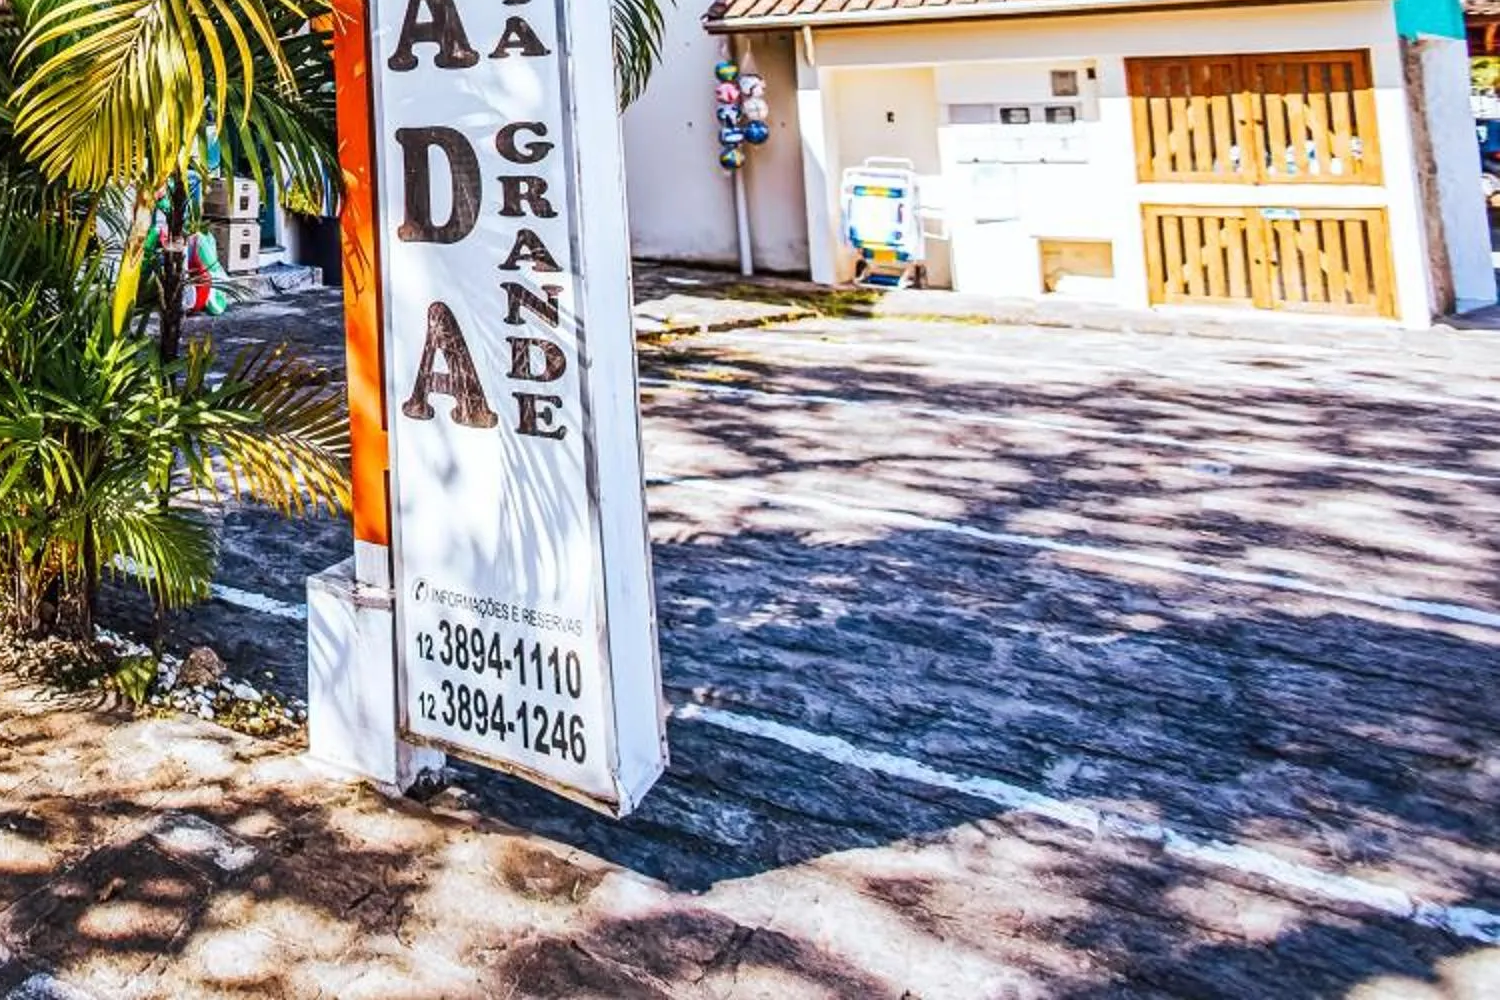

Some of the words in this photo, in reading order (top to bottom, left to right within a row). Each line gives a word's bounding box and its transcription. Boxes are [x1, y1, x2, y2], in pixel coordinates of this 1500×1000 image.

[495, 121, 567, 441] GRANDE
[416, 632, 435, 662] 12
[439, 620, 581, 699] 3894-1110
[511, 606, 519, 623] E
[522, 608, 583, 637] RESERVAS
[419, 691, 437, 722] 12
[442, 680, 586, 764] 3894-1246
